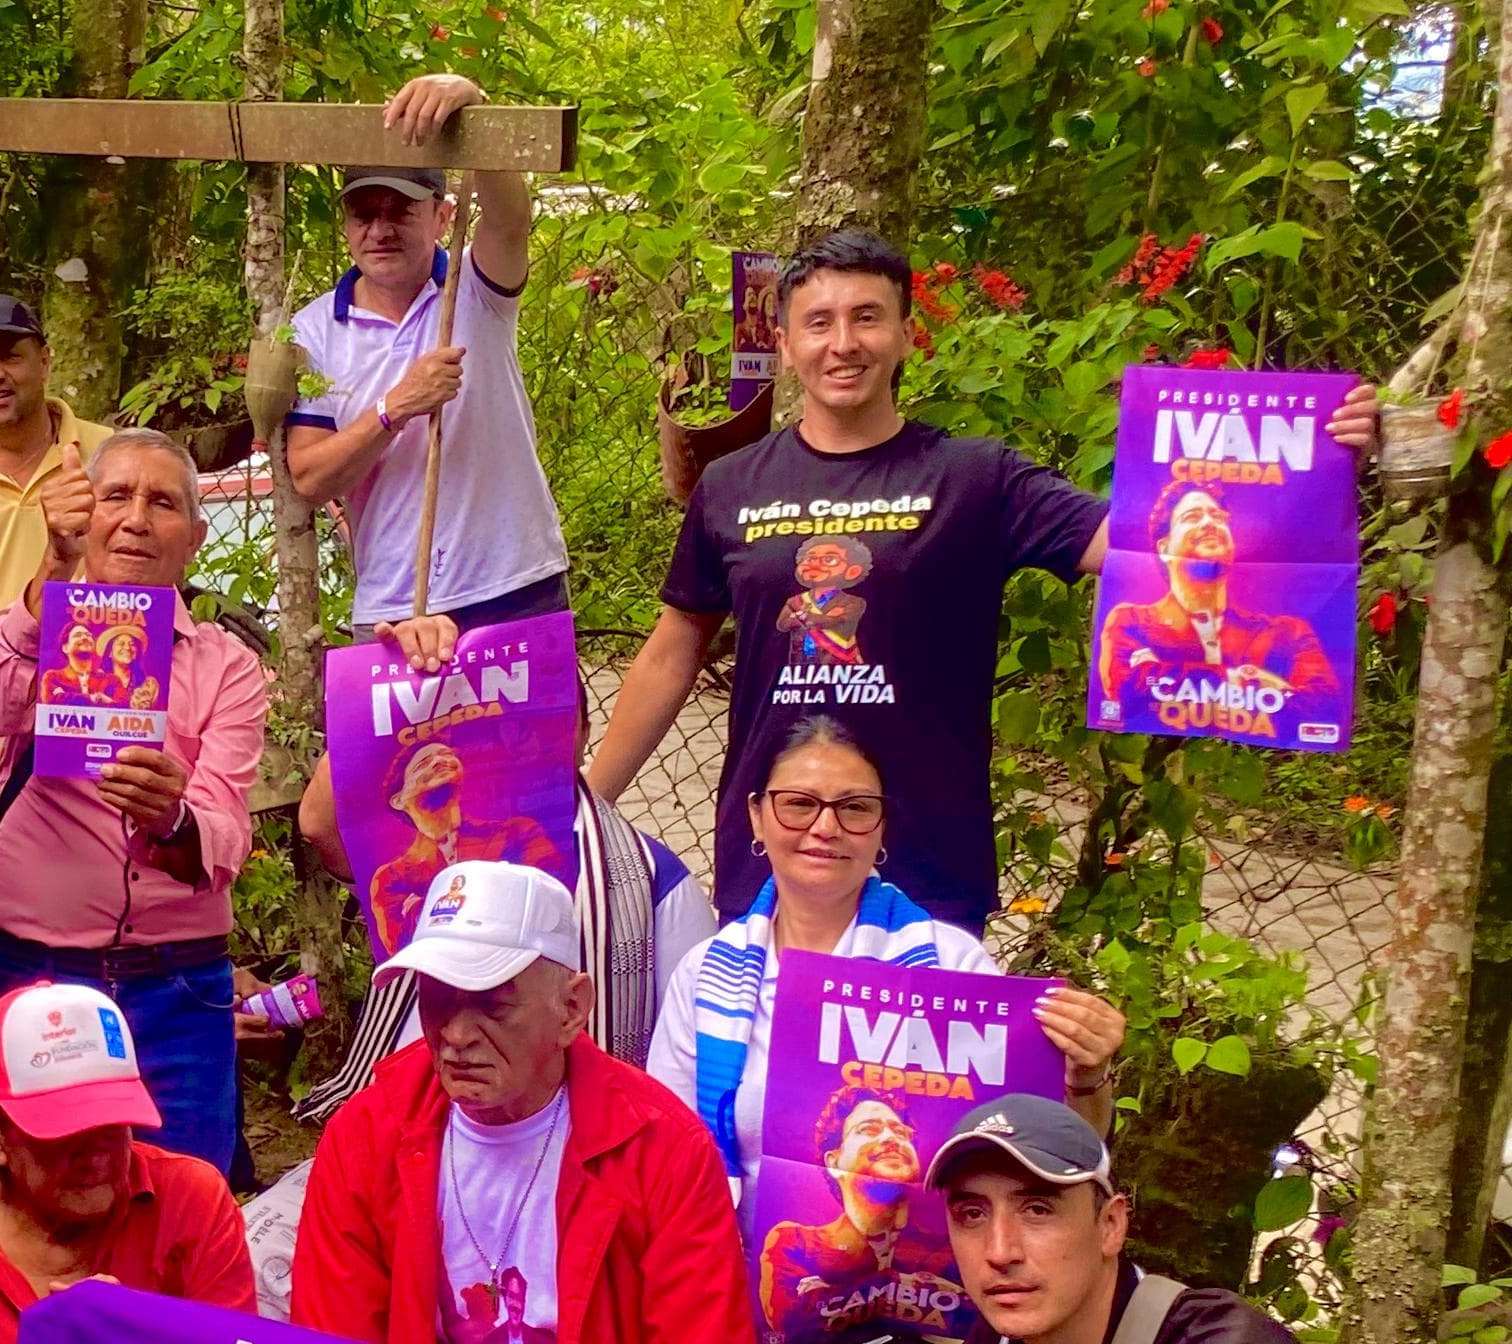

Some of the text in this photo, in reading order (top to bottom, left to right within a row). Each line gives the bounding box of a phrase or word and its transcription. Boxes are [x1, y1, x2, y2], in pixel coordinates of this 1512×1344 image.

[1158, 390, 1318, 409] PRESIDENTE
[1153, 408, 1316, 471] IVÁN
[1171, 459, 1284, 485] CEPEDA
[738, 495, 932, 524] Iván Cepeda
[745, 515, 919, 543] presidente
[68, 589, 152, 611] CAMBIO
[72, 607, 148, 627] QUEDA
[778, 664, 886, 685] ALIANZA
[371, 660, 529, 737] IVÁN
[772, 684, 896, 705] POR LA VIDA
[1151, 676, 1285, 714] CAMBIO
[107, 716, 155, 734] AIDA
[397, 701, 504, 747] CEPEDA
[1159, 702, 1277, 738] QUEDA
[823, 979, 1009, 1016] PRESIDENTE
[818, 1001, 1007, 1086] IVÁN
[841, 1060, 975, 1101] CEPEDA
[820, 1281, 961, 1318] CAMBIO
